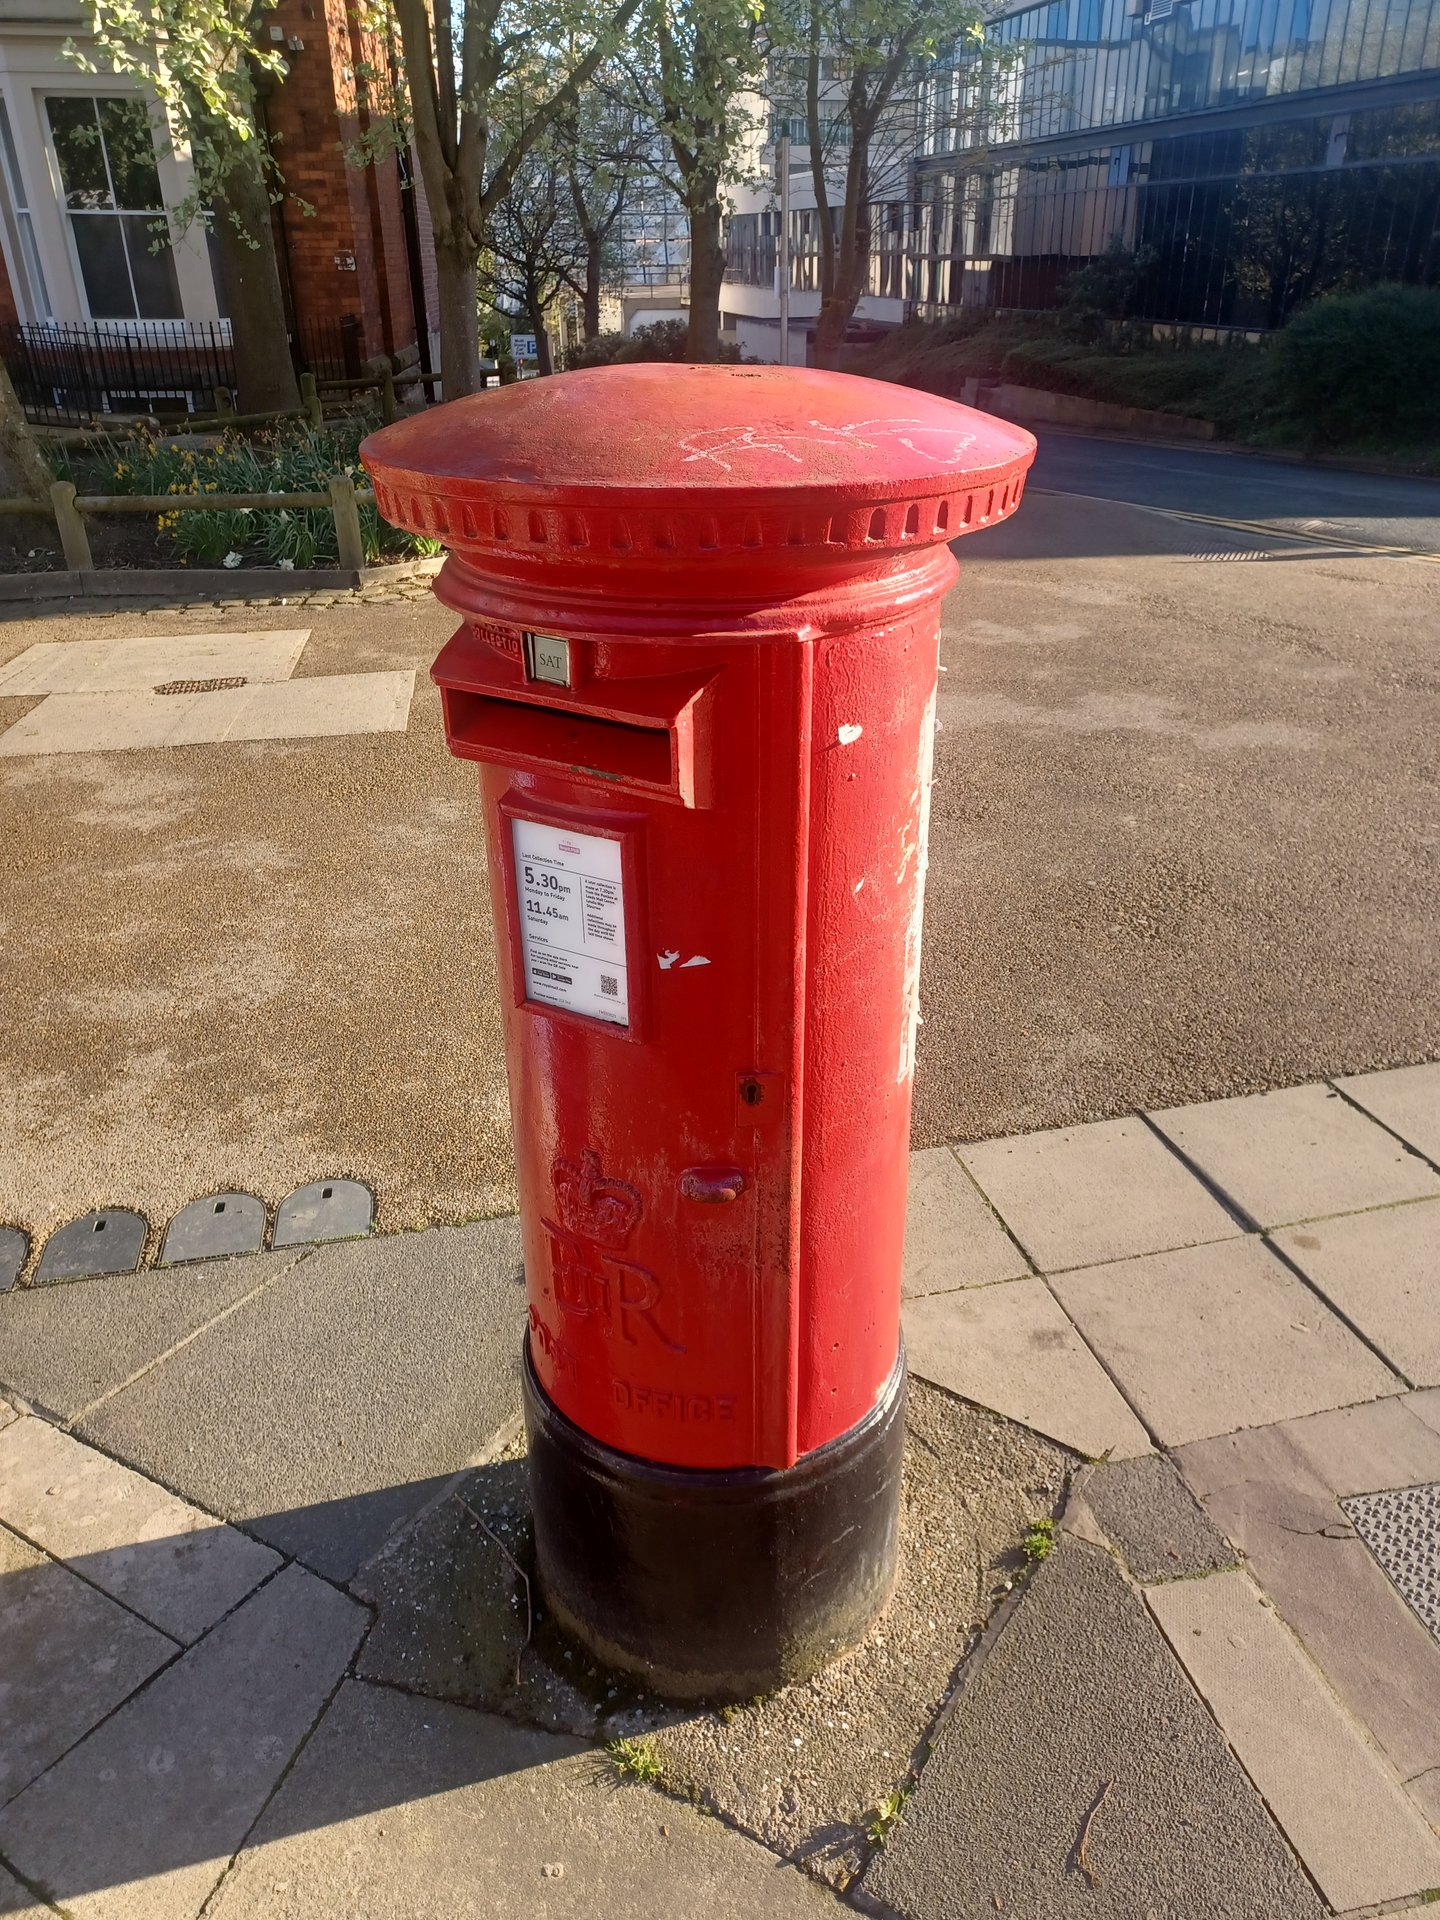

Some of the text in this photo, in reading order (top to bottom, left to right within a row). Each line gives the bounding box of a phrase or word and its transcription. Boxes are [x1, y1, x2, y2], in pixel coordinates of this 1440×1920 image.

[539, 653, 562, 669] SAT
[532, 855, 552, 863] Collection
[525, 866, 571, 894] 5.30pm
[525, 887, 543, 896] Monday
[550, 893, 565, 901] Friday
[526, 899, 568, 921] 11.45am
[527, 915, 548, 926] Saturday
[529, 933, 548, 942] Services
[611, 1375, 737, 1424] OFFICE
